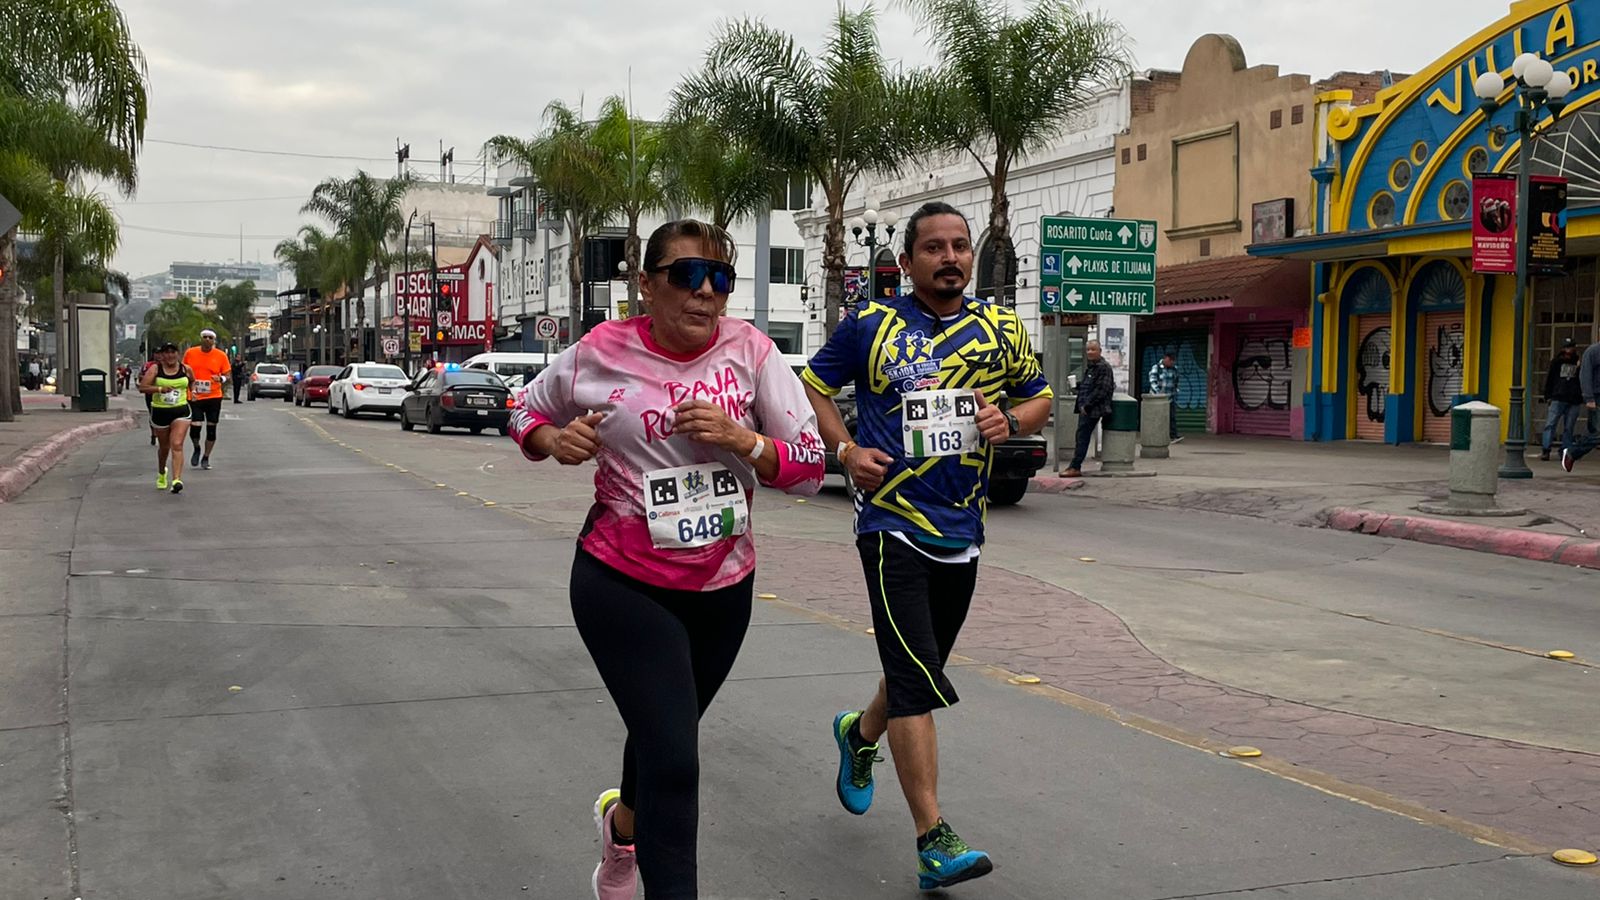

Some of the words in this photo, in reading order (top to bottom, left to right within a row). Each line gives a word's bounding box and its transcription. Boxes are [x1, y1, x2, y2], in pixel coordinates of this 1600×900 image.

[1047, 225, 1087, 240] ROSARITO
[1090, 227, 1113, 241] Cuota
[1083, 259, 1108, 273] PLAYAS
[1112, 261, 1120, 273] DE
[1123, 262, 1152, 274] TIJUANA
[1046, 293, 1056, 304] 5
[1089, 291, 1107, 305] ALL
[1111, 291, 1147, 307] TRAFFIC
[541, 321, 554, 332] 40
[664, 366, 739, 407] BAJA
[929, 431, 962, 451] 163
[678, 514, 723, 543] 648
